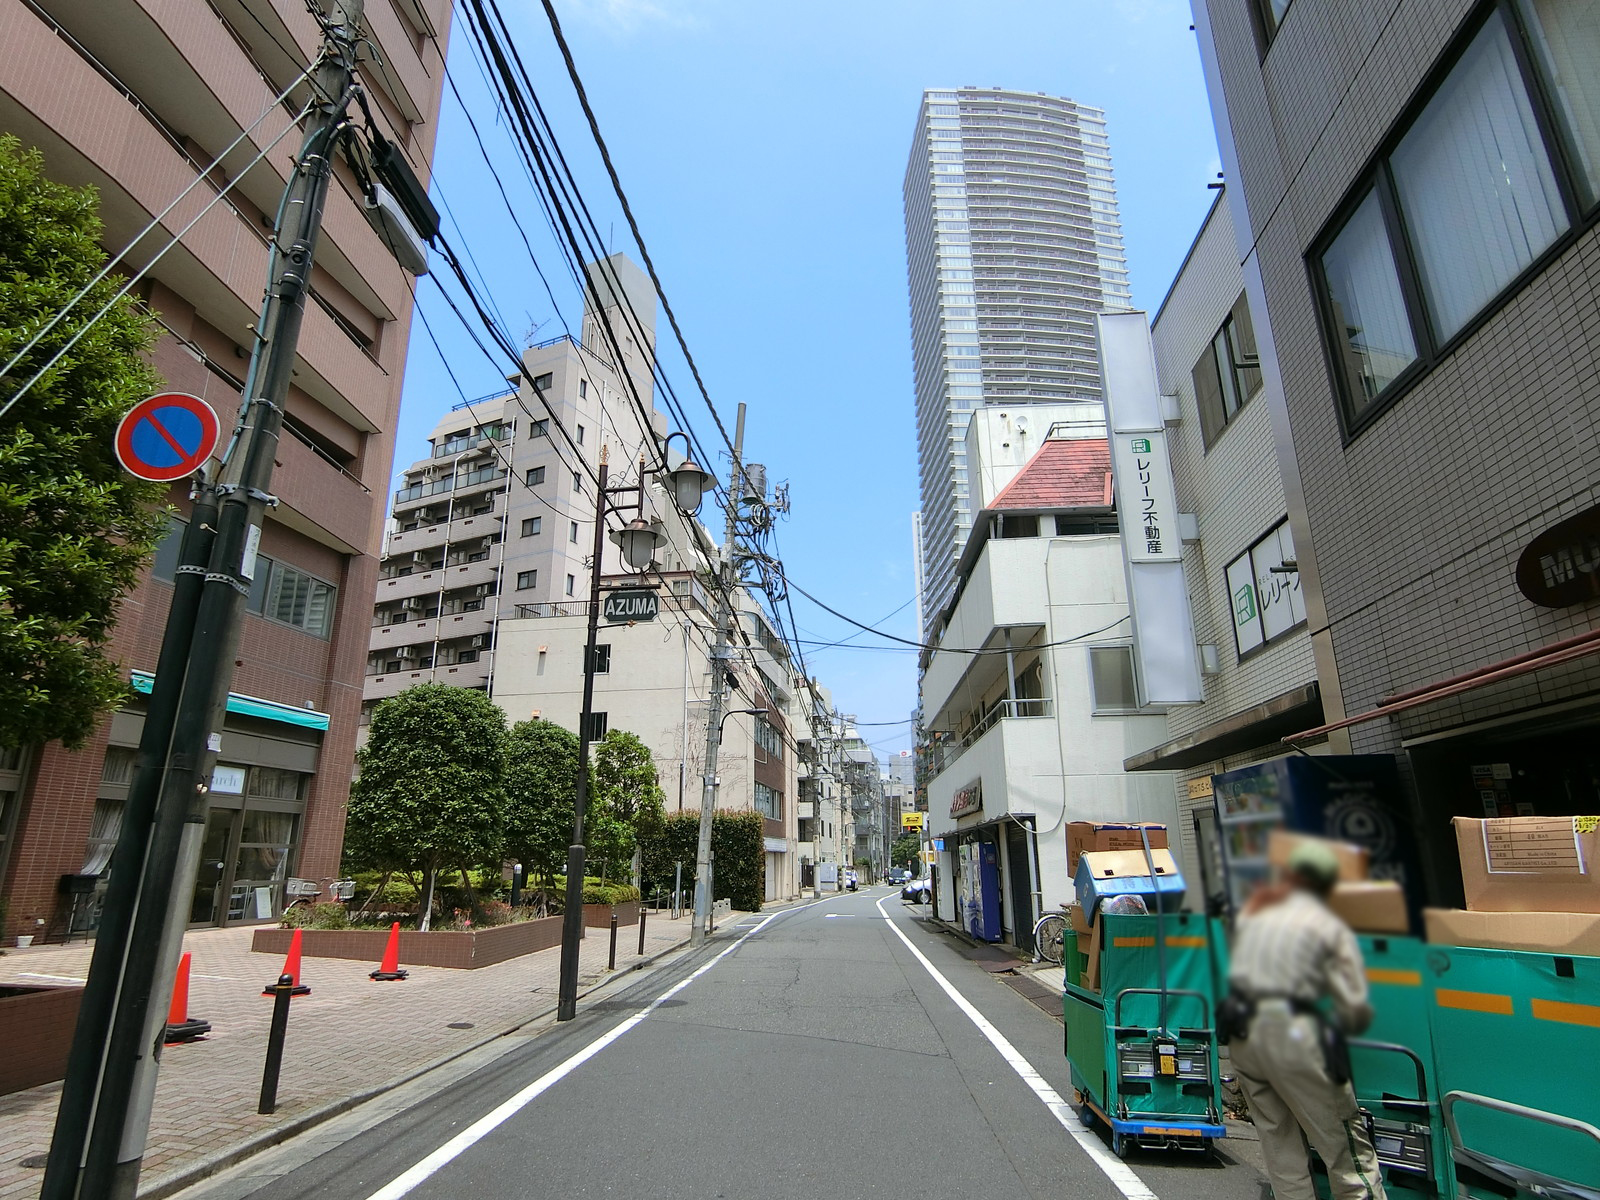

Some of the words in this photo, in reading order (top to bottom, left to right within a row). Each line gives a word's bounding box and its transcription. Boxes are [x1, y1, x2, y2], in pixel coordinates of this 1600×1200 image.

[1137, 458, 1163, 554] レリーフ不動産
[605, 597, 657, 616] AZUMA
